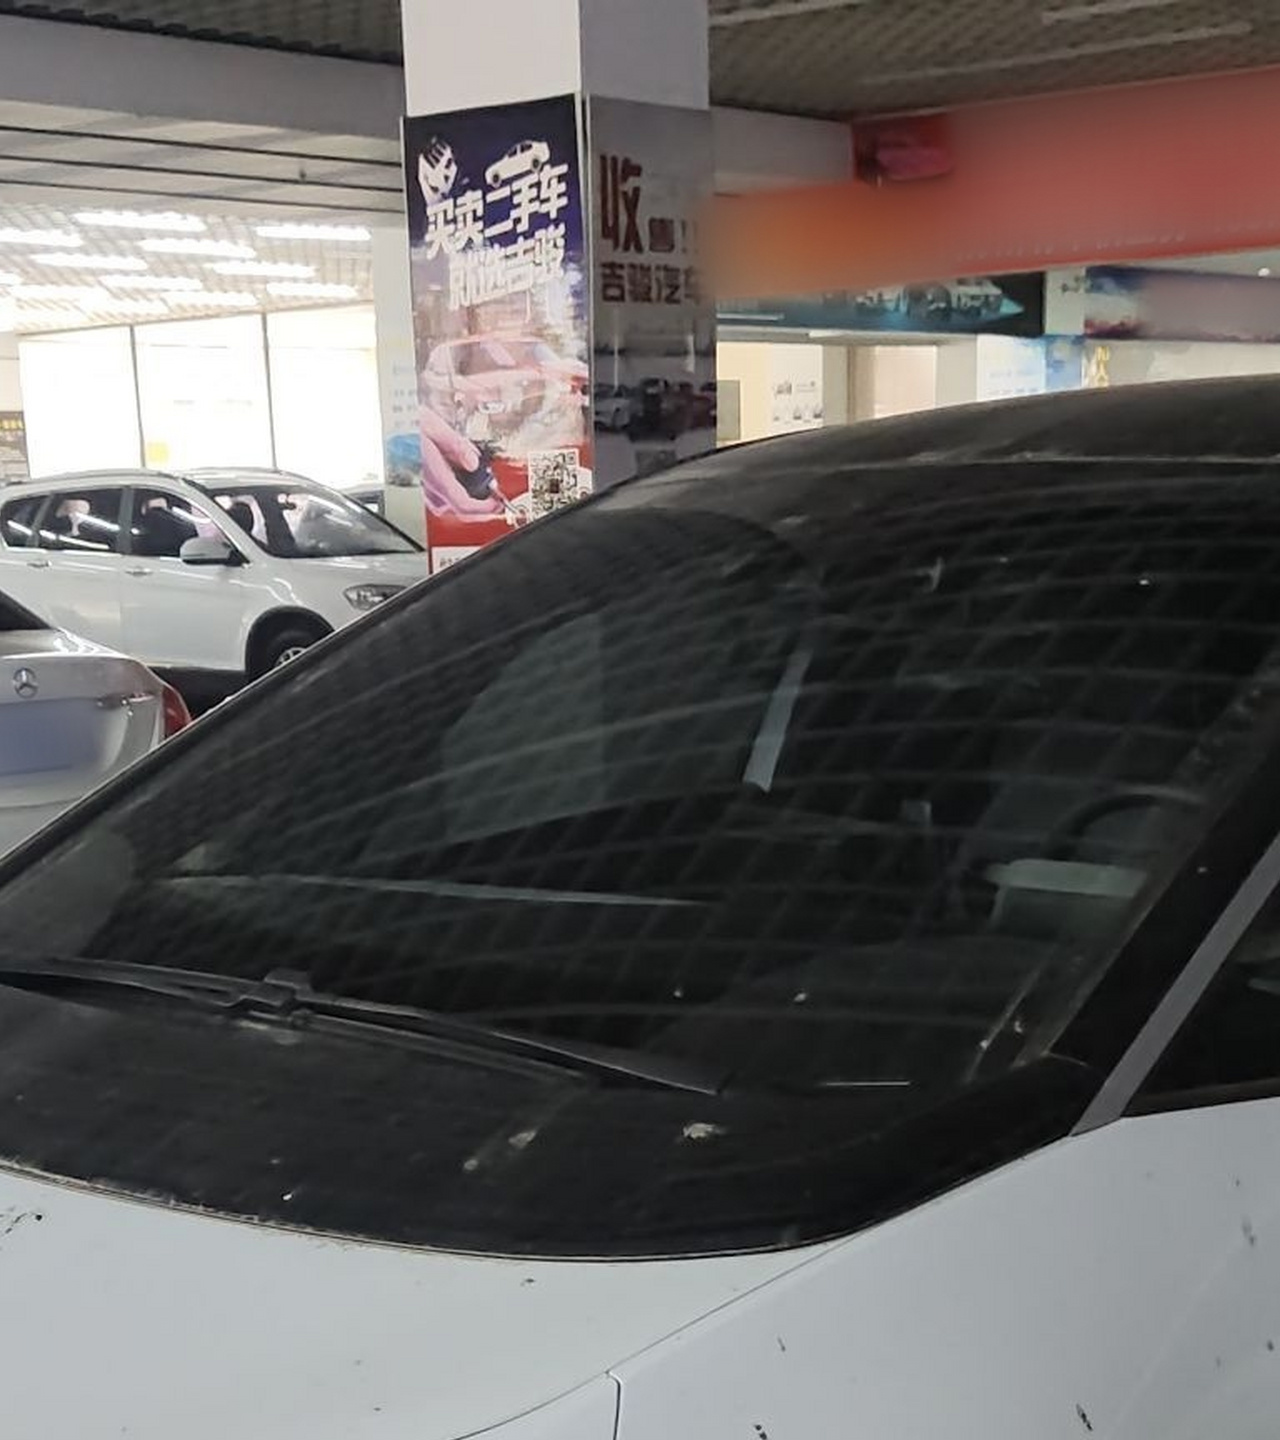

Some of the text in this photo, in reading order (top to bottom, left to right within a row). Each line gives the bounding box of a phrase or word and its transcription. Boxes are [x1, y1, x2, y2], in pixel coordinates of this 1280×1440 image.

[425, 163, 568, 260] 买卖二手车
